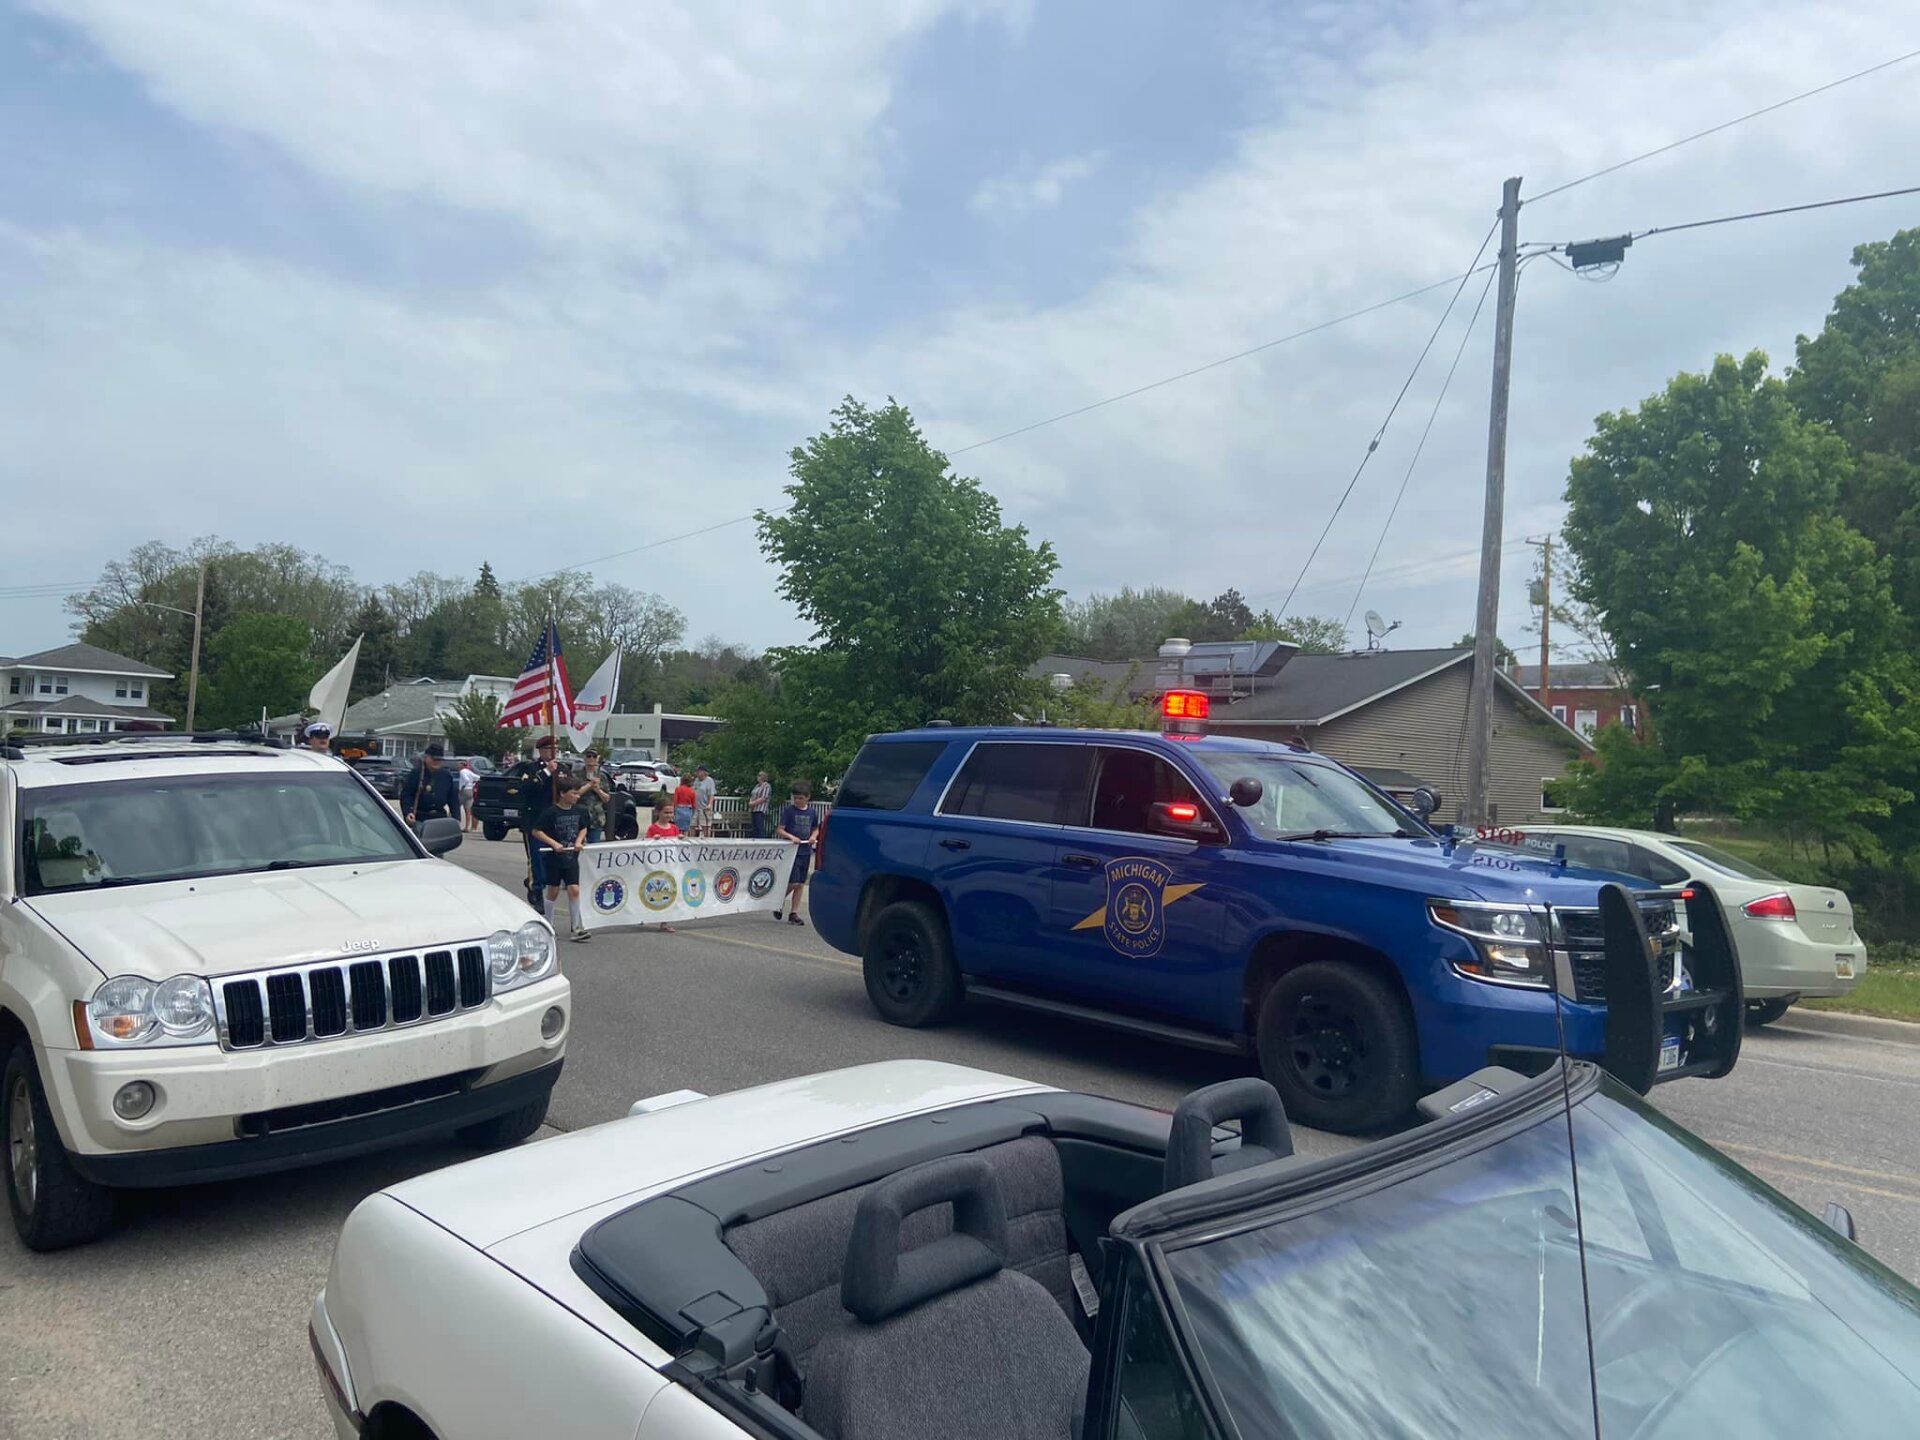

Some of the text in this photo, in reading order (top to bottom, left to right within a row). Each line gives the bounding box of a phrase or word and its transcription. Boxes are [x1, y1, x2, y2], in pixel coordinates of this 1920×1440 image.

[1476, 825, 1525, 846] STOP
[596, 845, 785, 869] HONOR & REMEMBER
[1111, 864, 1165, 887] MICHIGAN
[340, 939, 380, 952] Jeep
[1108, 921, 1160, 949] STATE POLICE
